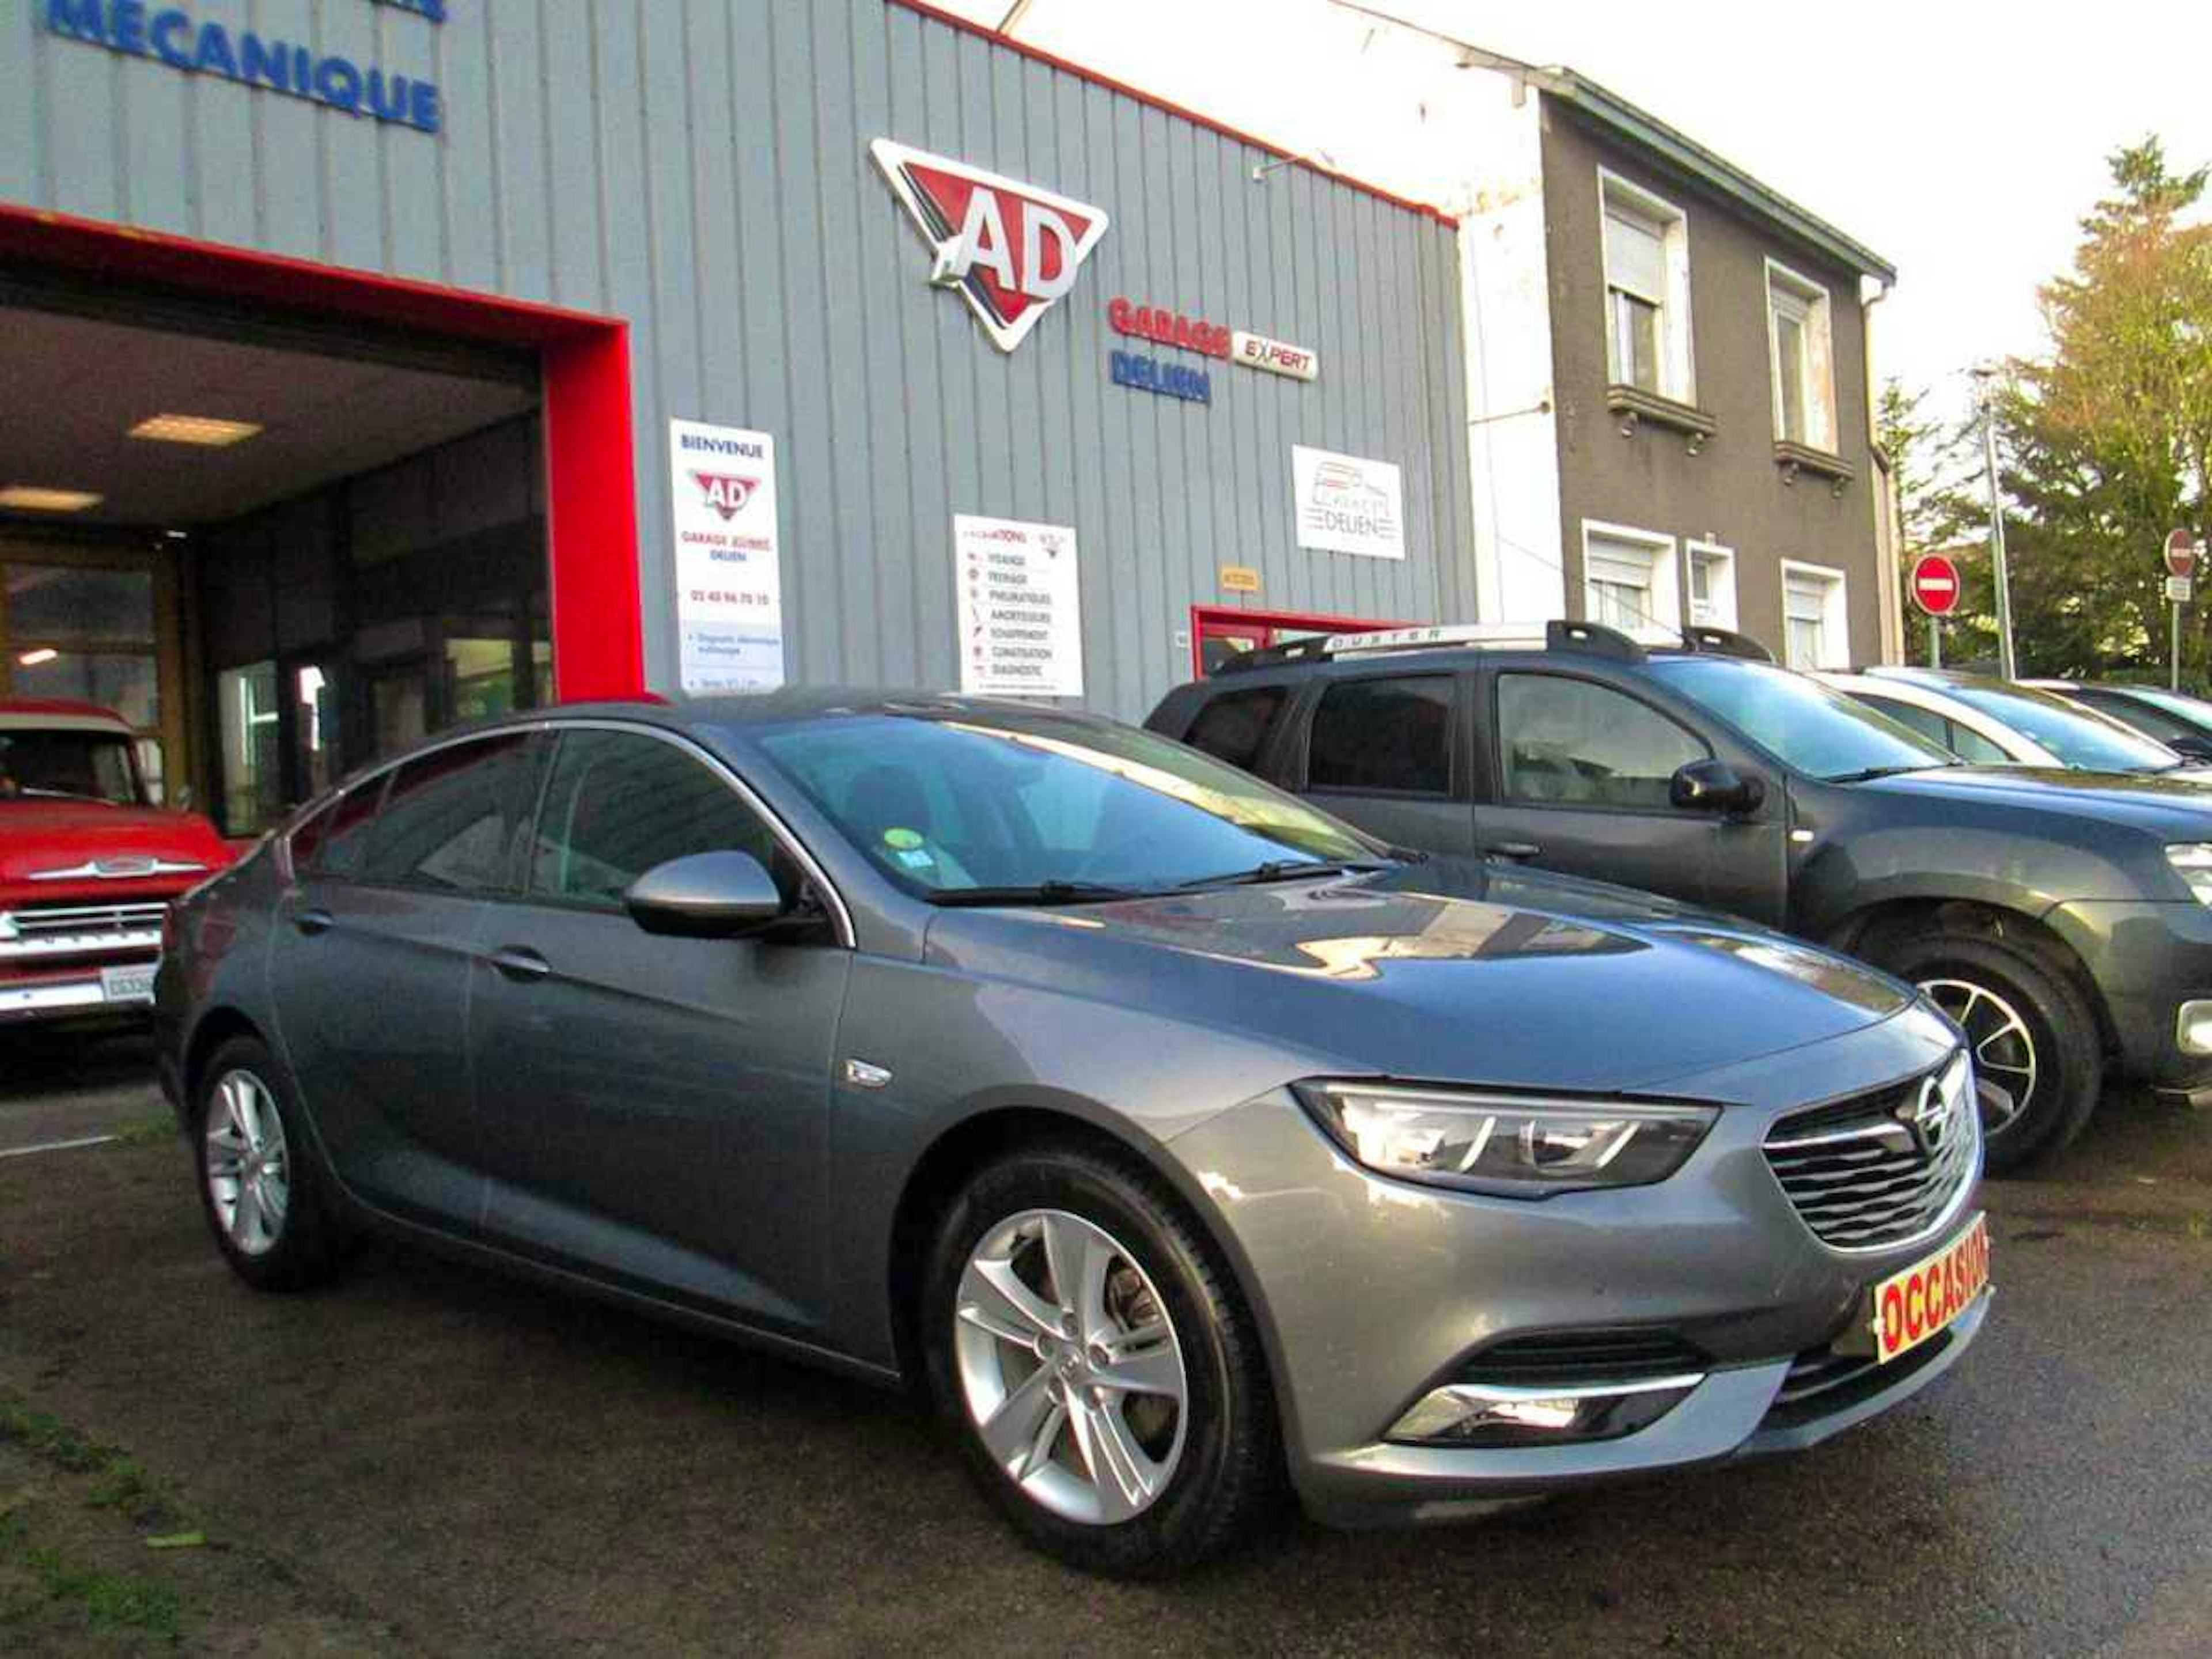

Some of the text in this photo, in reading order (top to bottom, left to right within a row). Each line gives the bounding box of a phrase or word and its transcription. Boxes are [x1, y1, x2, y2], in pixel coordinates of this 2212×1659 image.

[953, 185, 1078, 298] AD
[1109, 297, 1312, 371] GARAGE EXPERT
[1112, 350, 1212, 402] DELIEN
[680, 434, 764, 459] BIENVENUE
[706, 477, 748, 509] AD
[681, 531, 727, 546] GARAGE
